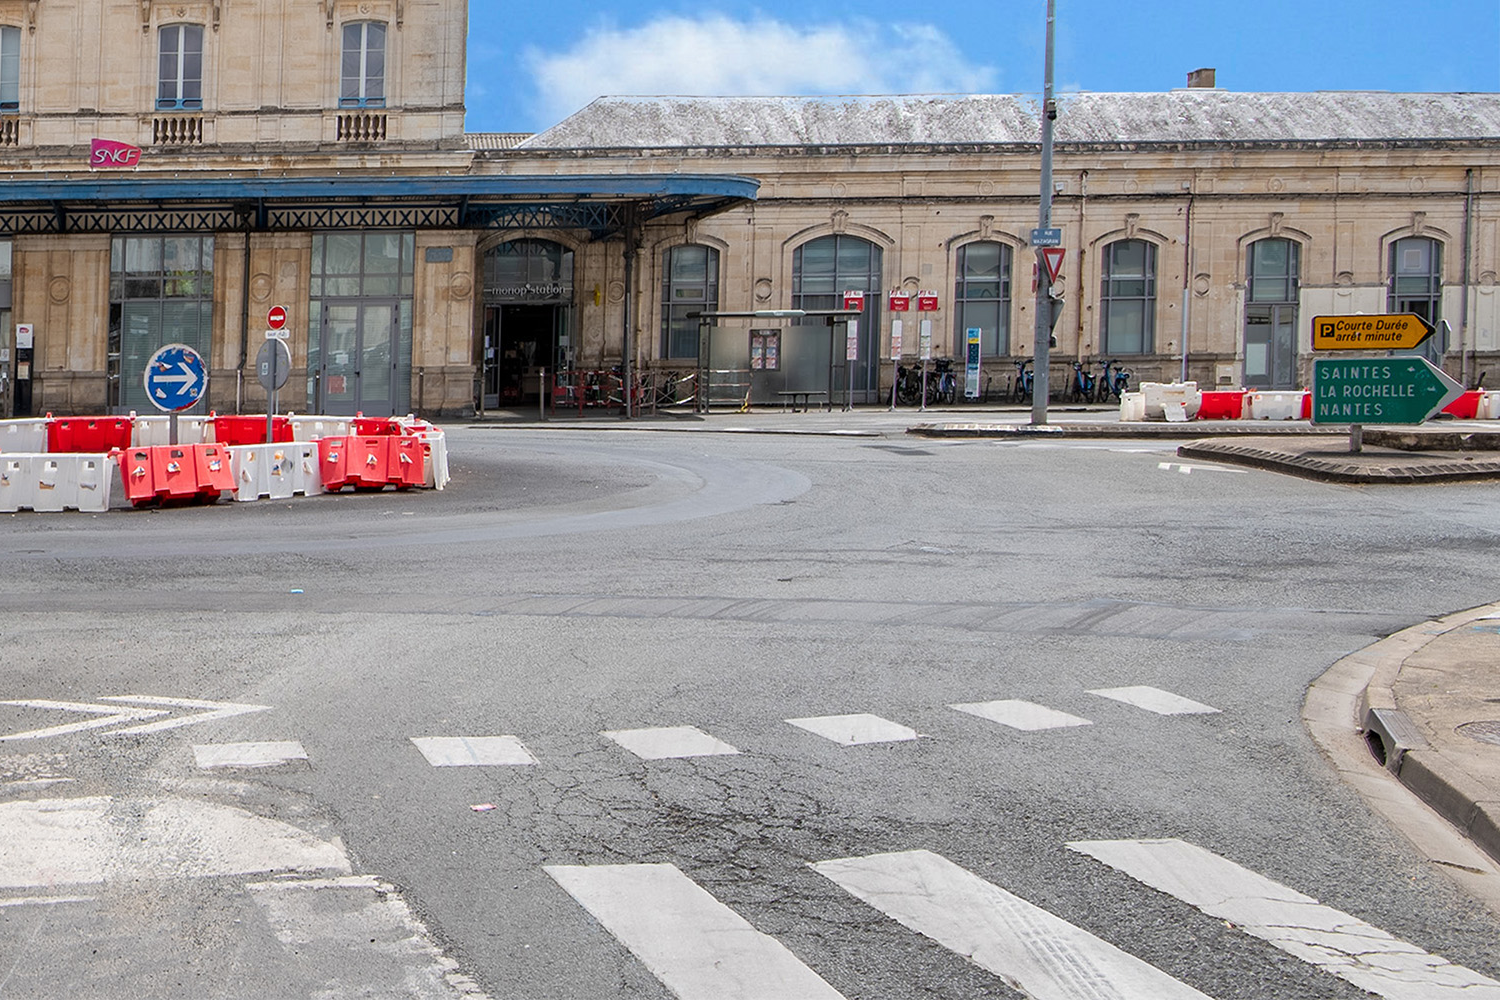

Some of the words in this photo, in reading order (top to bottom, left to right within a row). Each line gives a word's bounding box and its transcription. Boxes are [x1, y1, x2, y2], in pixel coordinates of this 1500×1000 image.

[93, 149, 138, 164] SNCF
[1335, 320, 1373, 331] Courte
[1375, 319, 1409, 330] Durée
[1335, 331, 1362, 341] arrêt
[1364, 331, 1403, 341] minute
[1321, 366, 1391, 380] SAINTES
[1320, 385, 1337, 398] LA
[1343, 384, 1416, 398] ROCHELLE
[1320, 403, 1383, 416] NANTES
